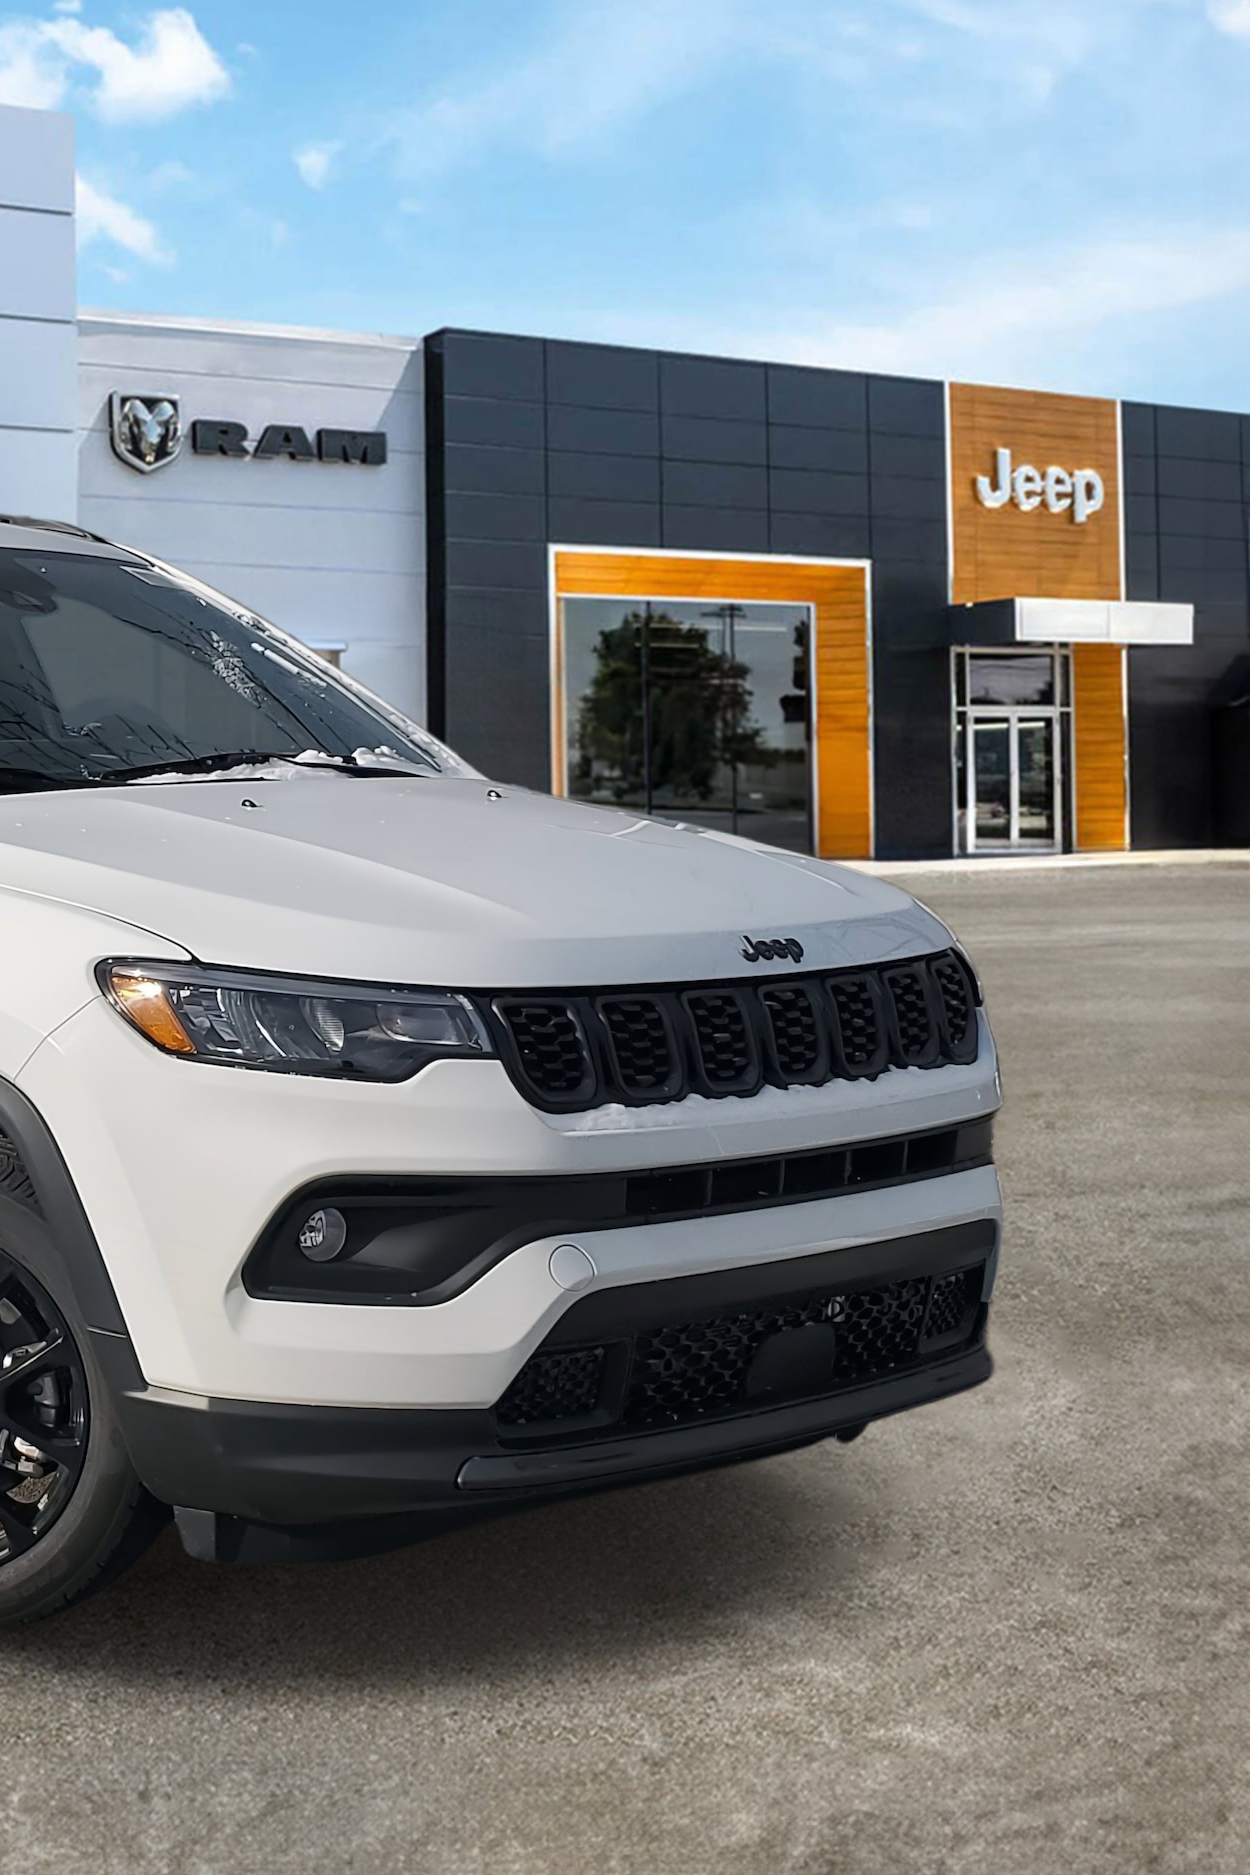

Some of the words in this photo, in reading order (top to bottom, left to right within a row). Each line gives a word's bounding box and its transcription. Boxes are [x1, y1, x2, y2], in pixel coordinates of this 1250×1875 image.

[191, 419, 387, 465] RAM
[975, 447, 1104, 524] Jeep
[739, 935, 804, 963] Jeep
